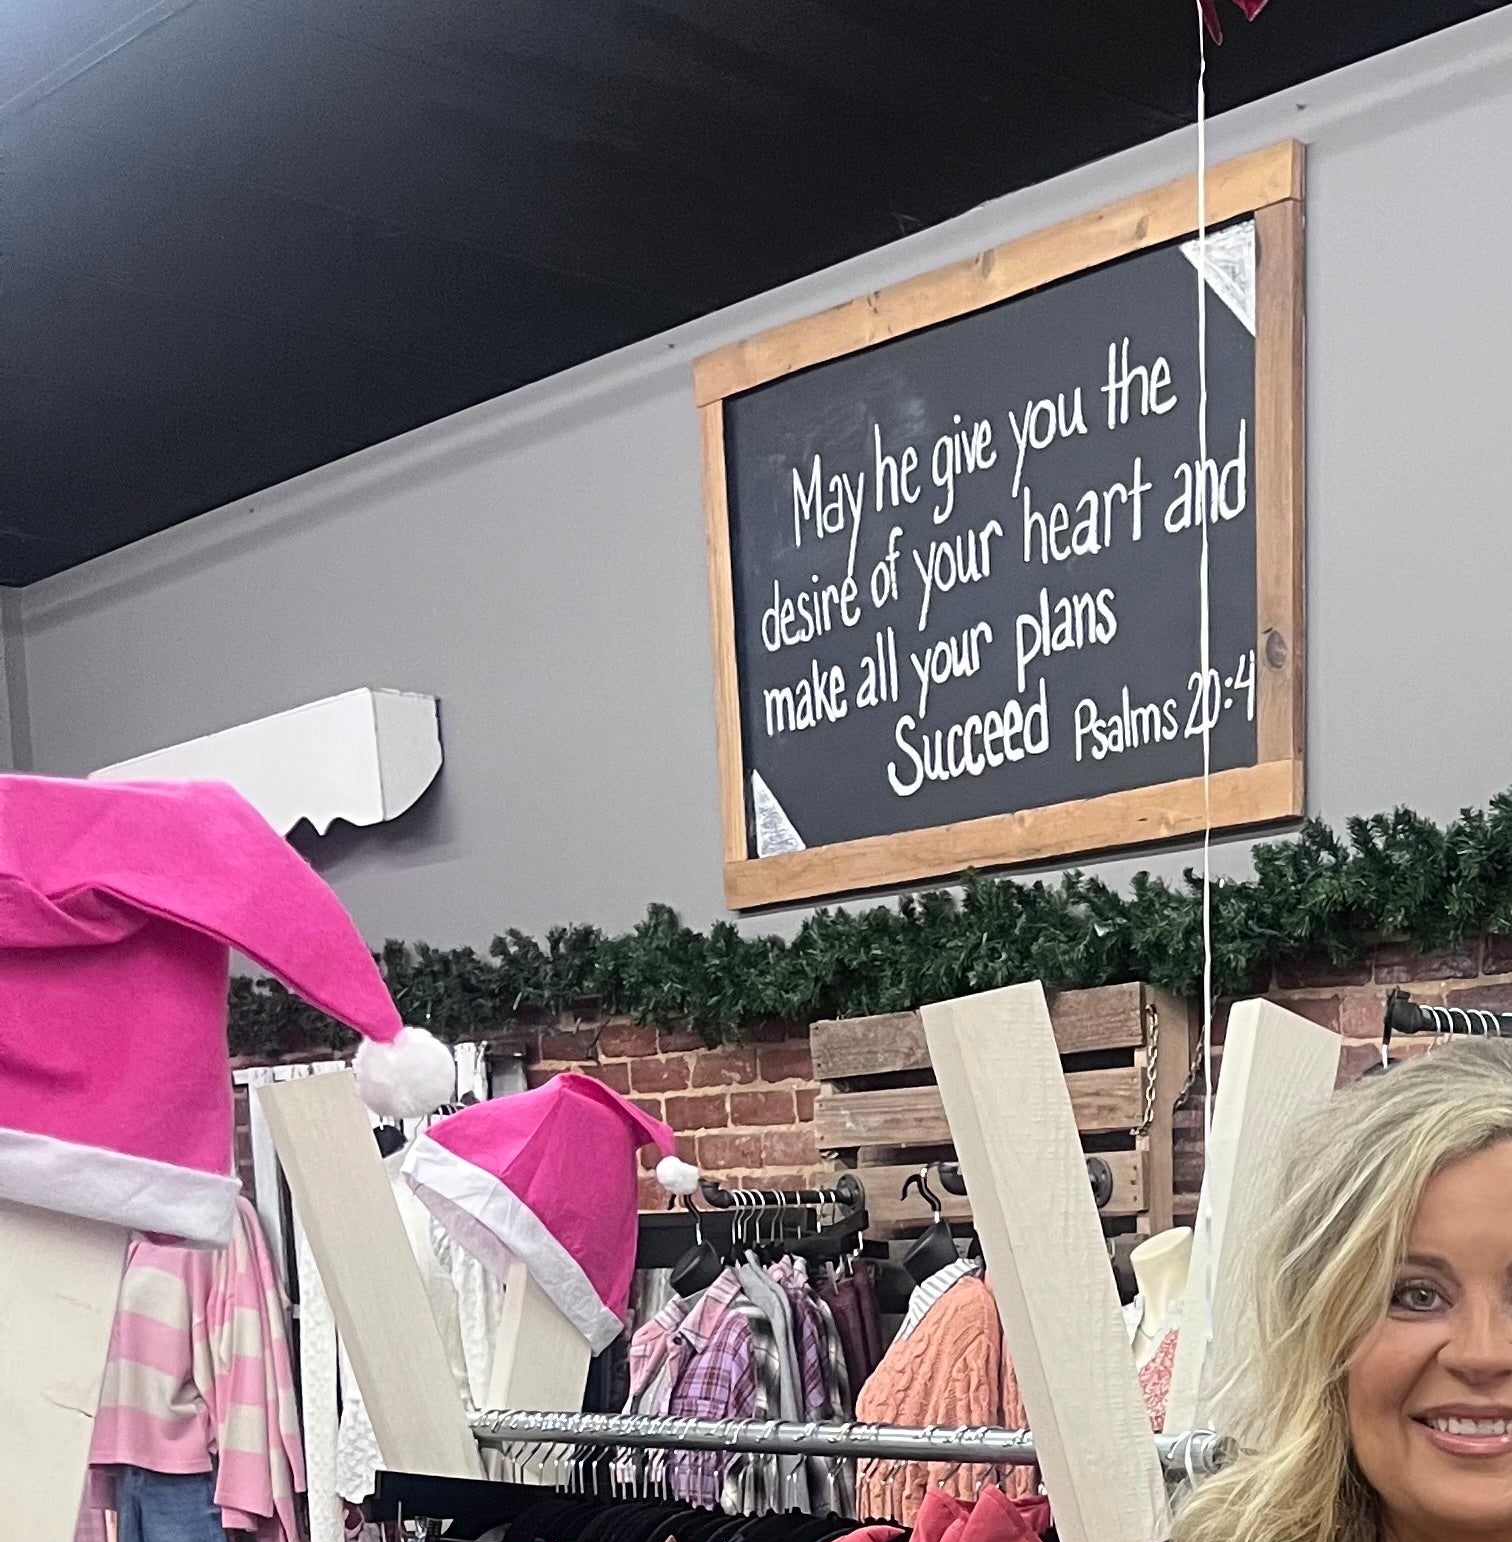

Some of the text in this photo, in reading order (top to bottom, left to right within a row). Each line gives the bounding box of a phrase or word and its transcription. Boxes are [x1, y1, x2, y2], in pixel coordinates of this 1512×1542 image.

[760, 417, 1248, 653] desire of your heart and
[791, 335, 1179, 575] May he give you the
[762, 586, 1119, 738] make all your plans
[886, 648, 1257, 798] Succeed Psalms 20:4
